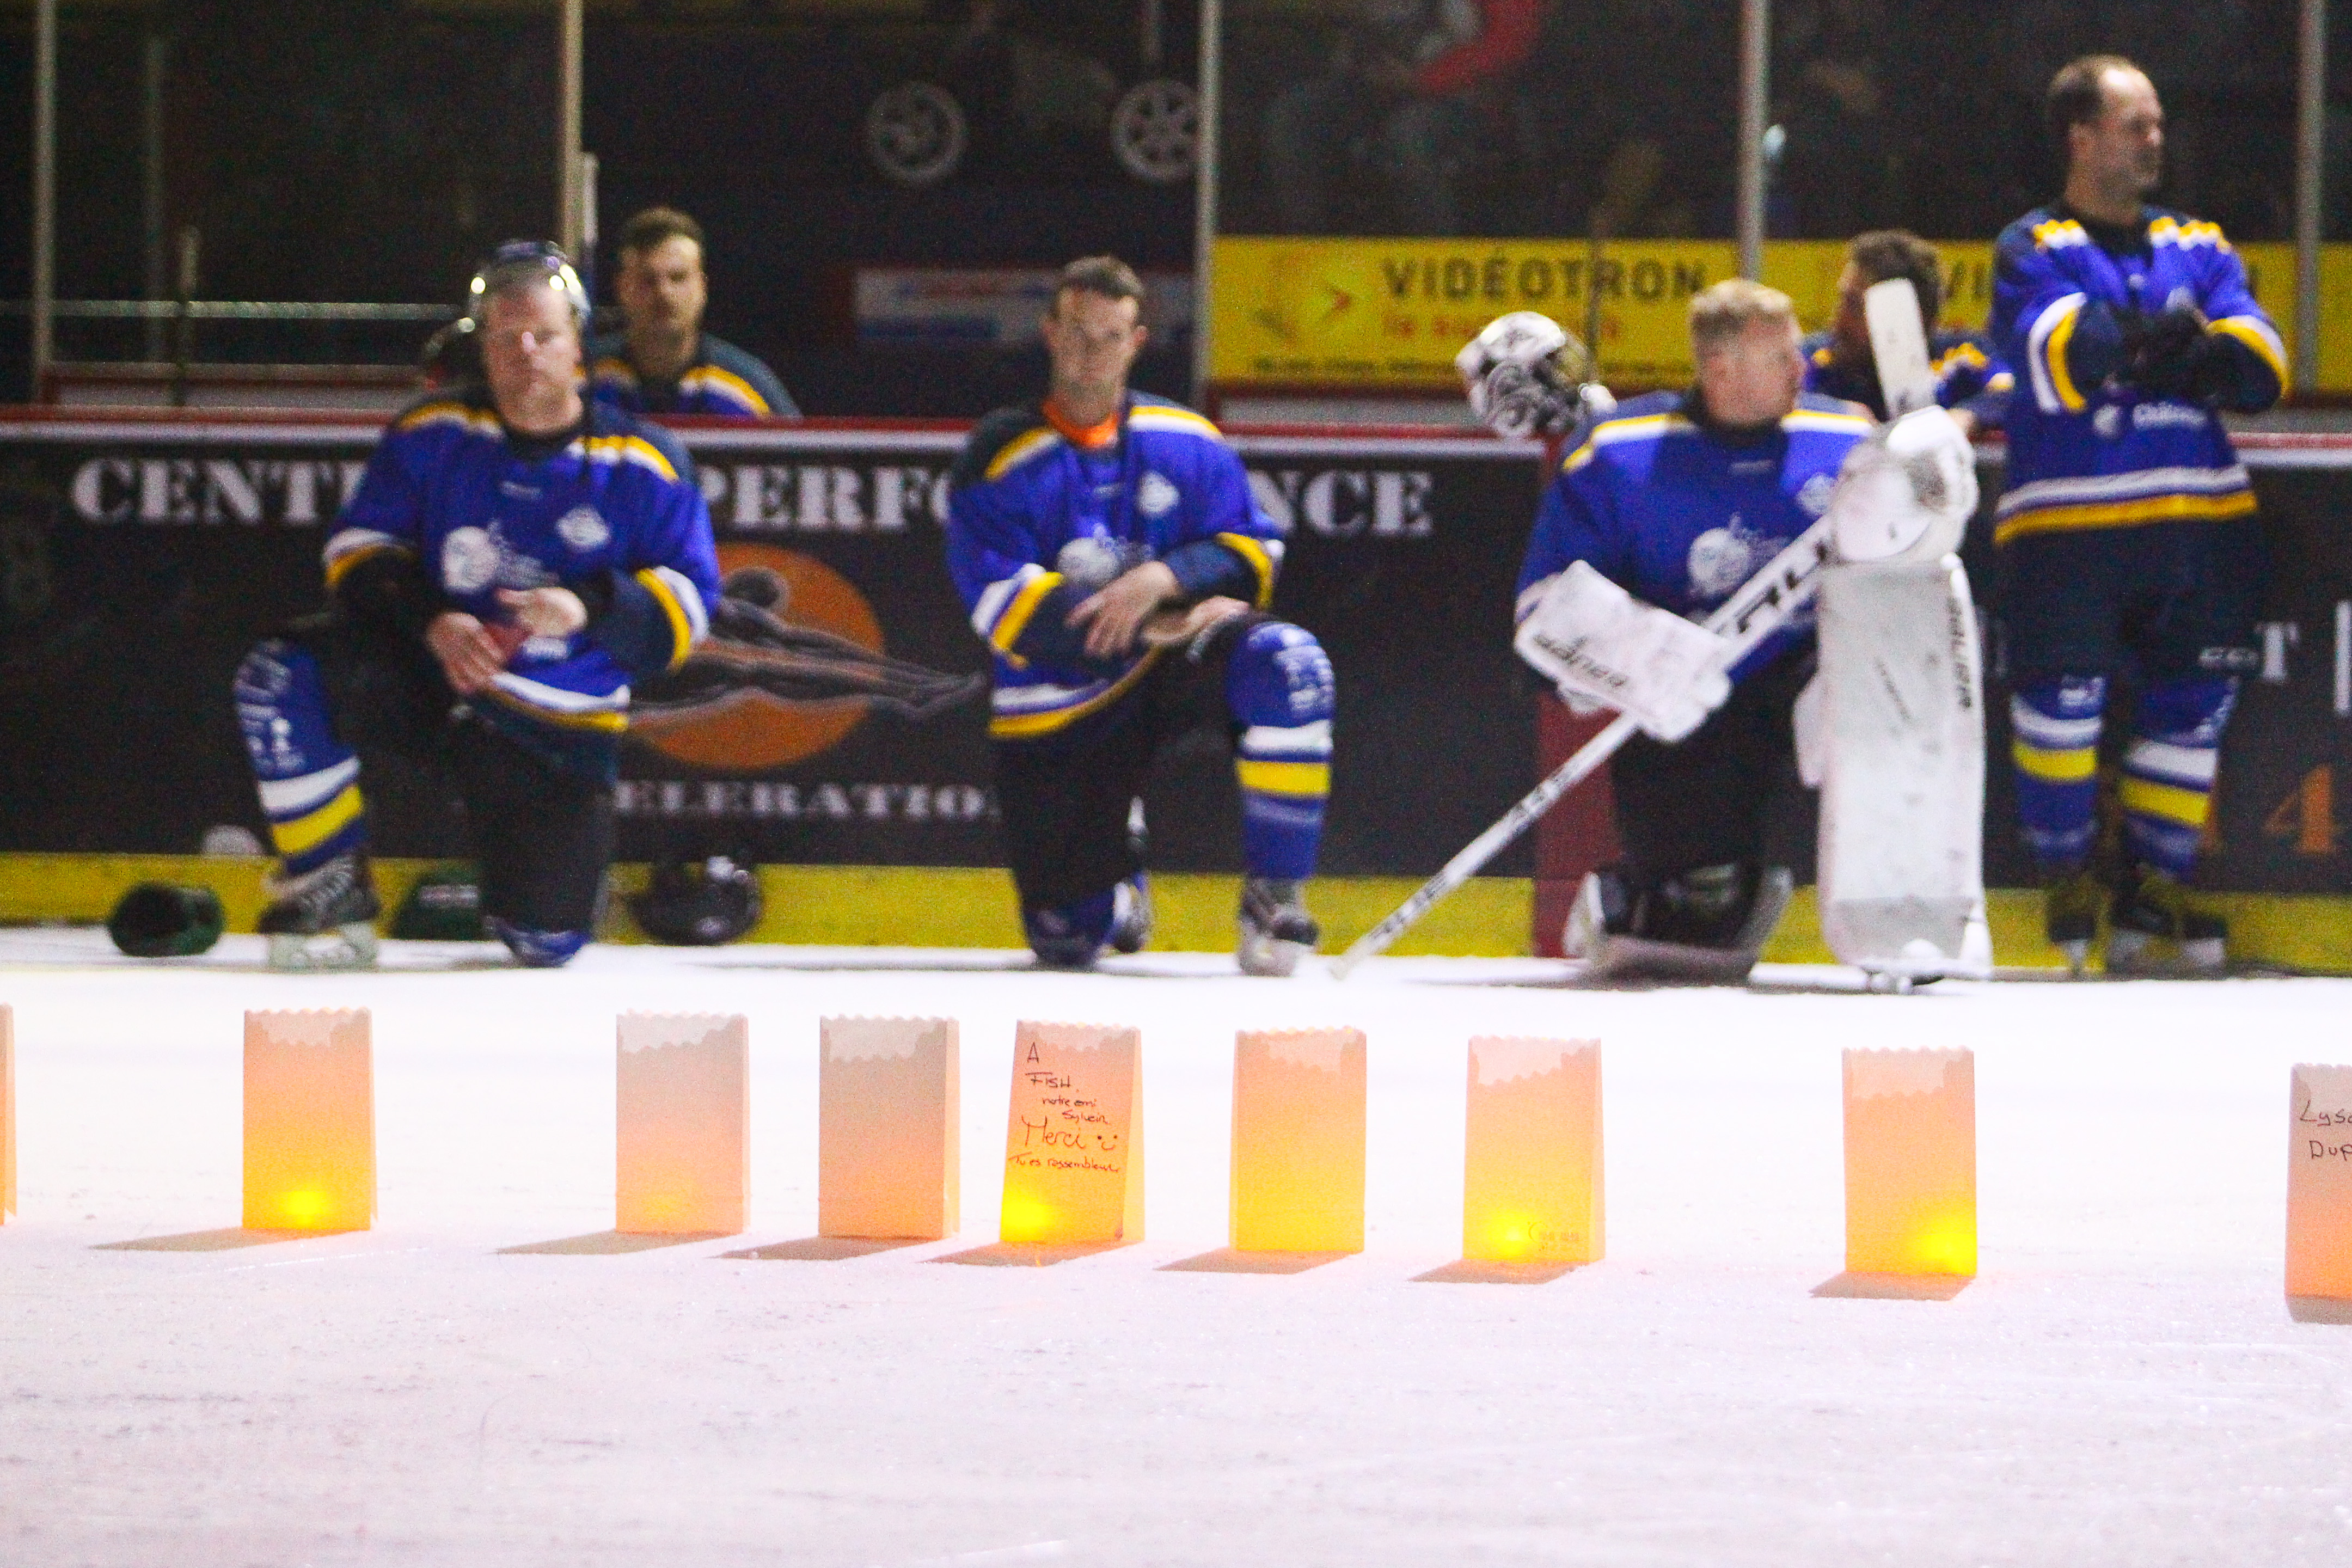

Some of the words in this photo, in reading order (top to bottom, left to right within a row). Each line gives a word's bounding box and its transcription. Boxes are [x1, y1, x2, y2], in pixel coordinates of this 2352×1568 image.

[1381, 247, 1706, 301] VIDÉOTRON
[1026, 1042, 1040, 1064] A
[1021, 1114, 1087, 1150] Merci
